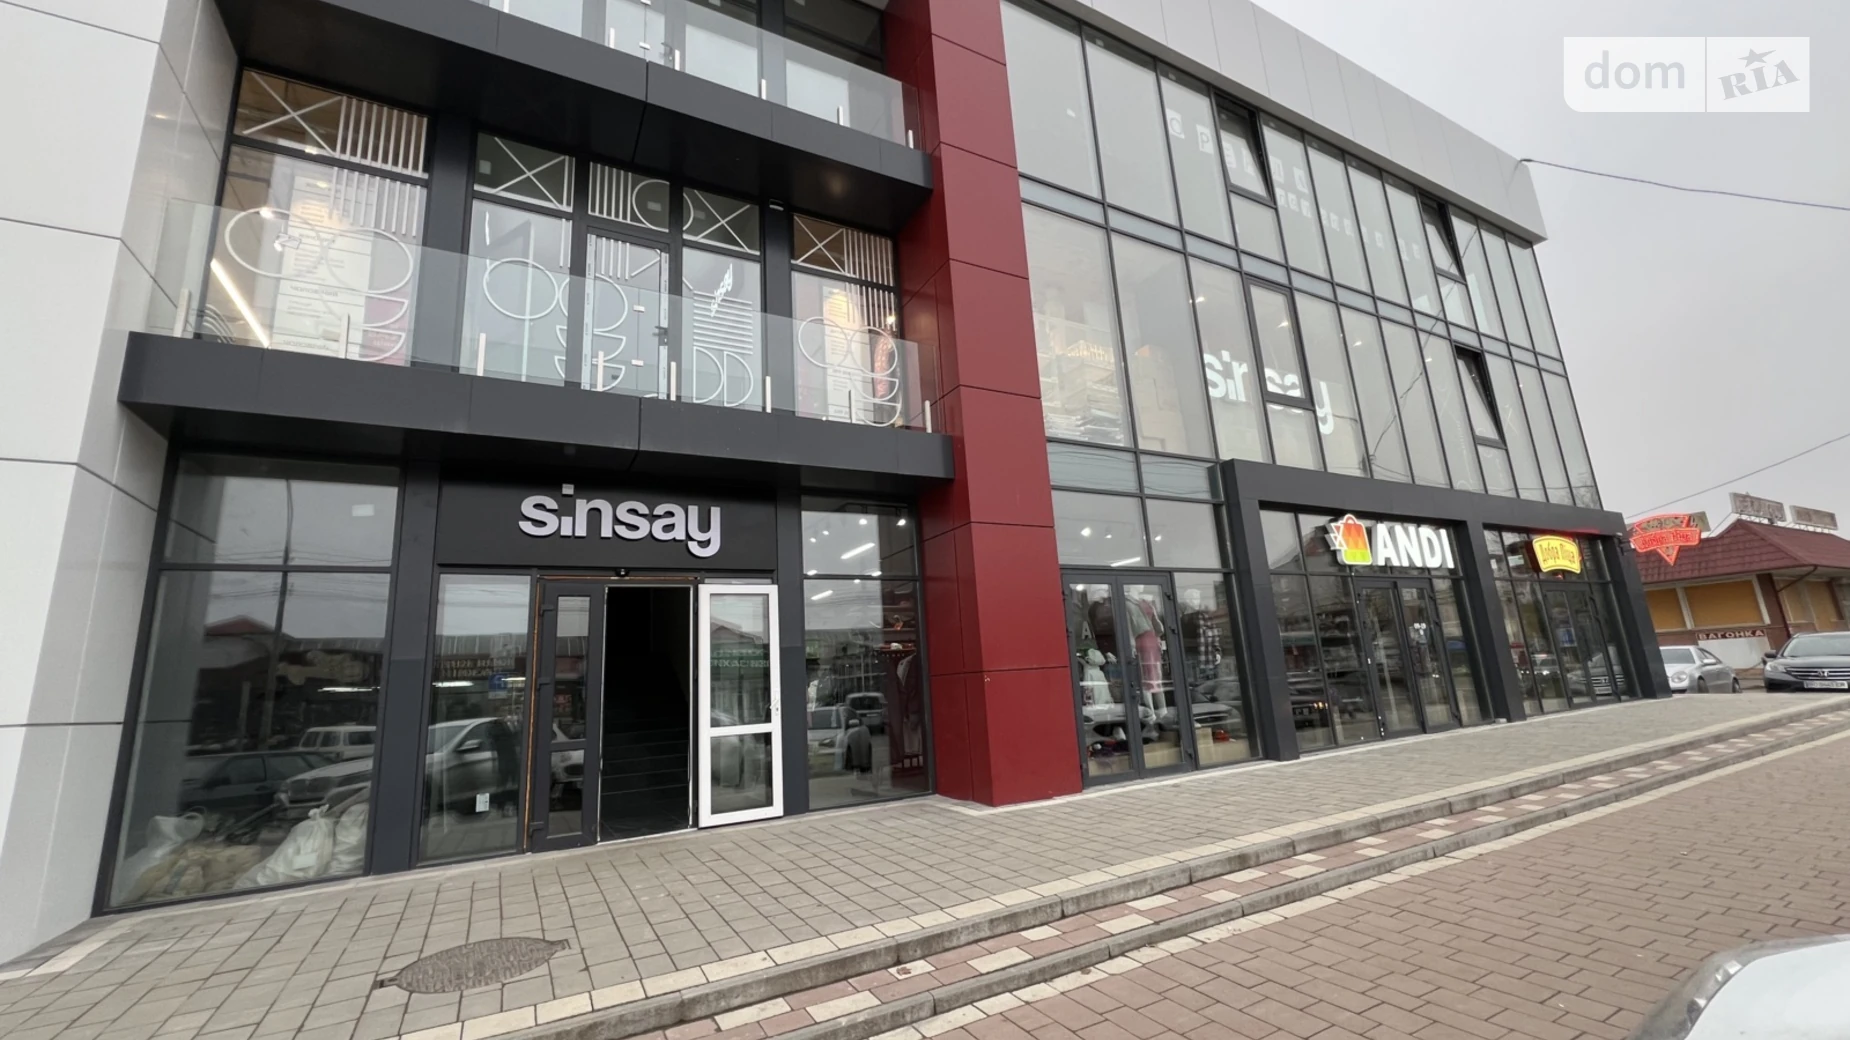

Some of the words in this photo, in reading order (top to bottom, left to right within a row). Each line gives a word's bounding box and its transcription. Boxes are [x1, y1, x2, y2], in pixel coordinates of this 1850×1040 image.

[518, 483, 721, 558] sinsay
[1375, 522, 1455, 569] ANDI
[1698, 628, 1765, 641] ВАГОНКА
